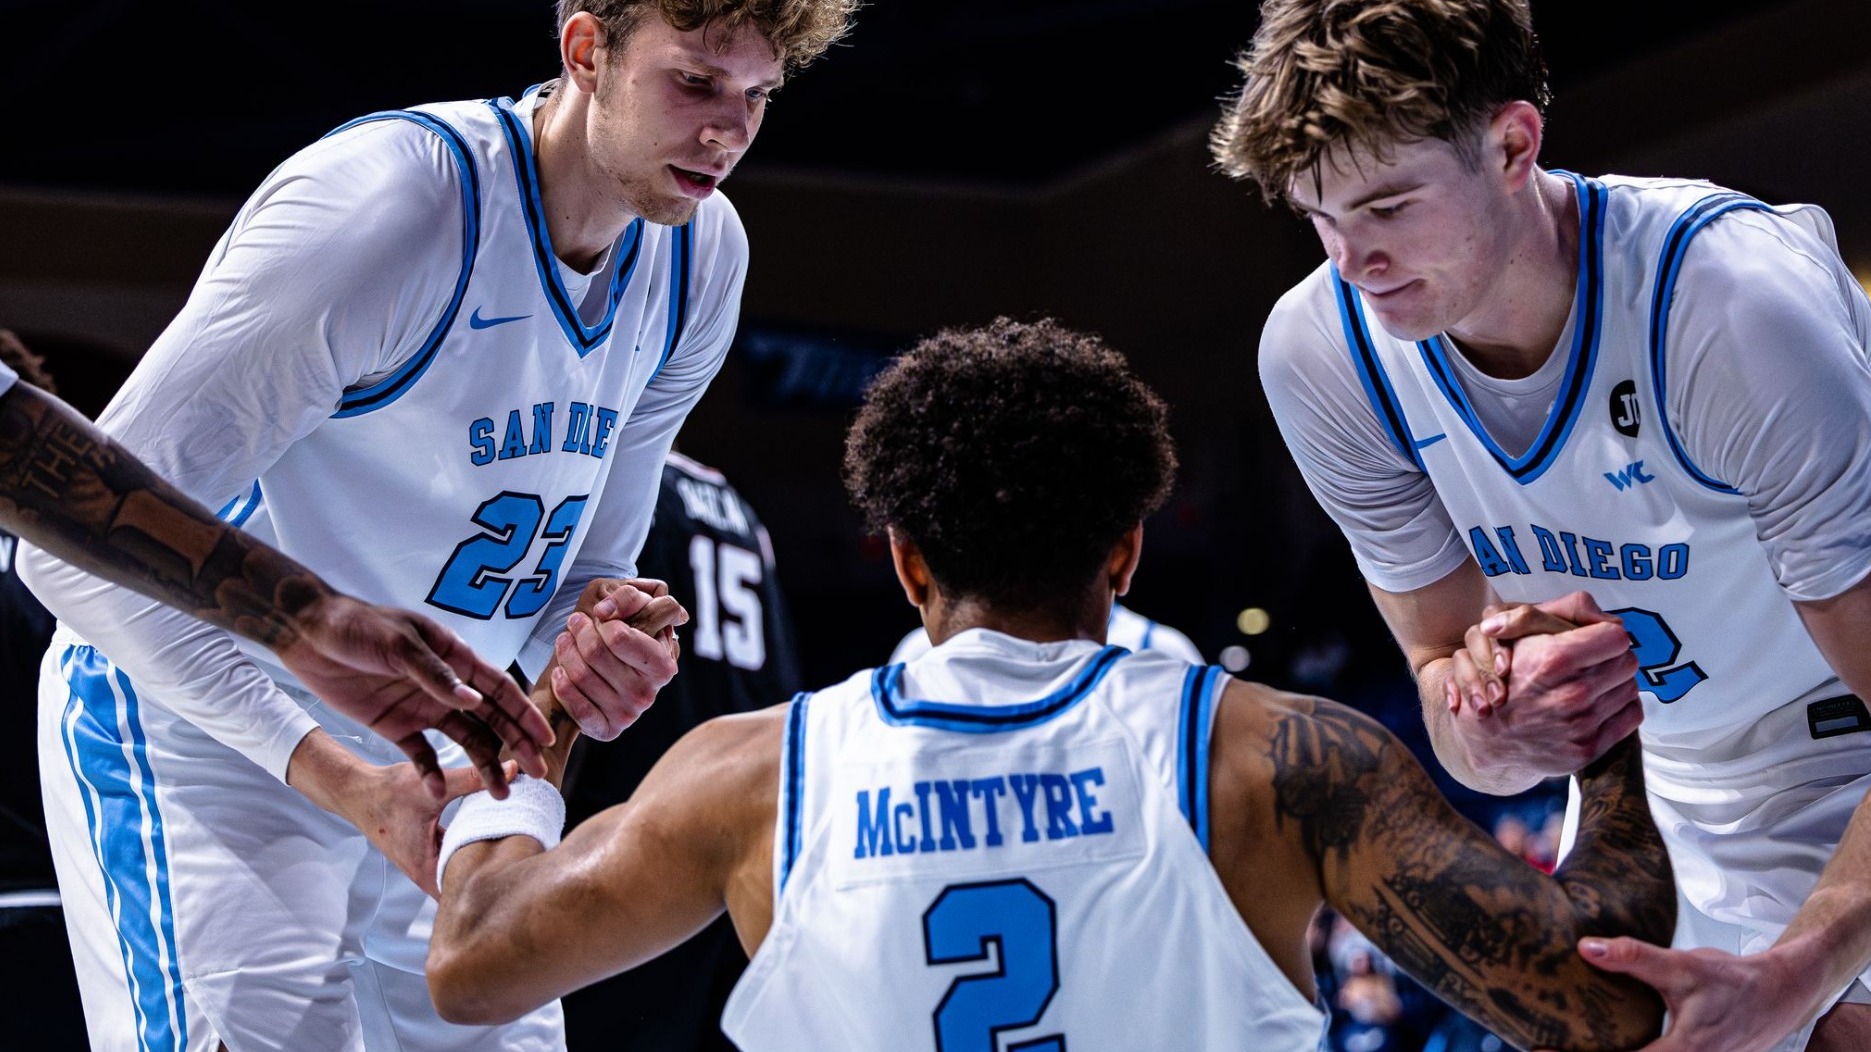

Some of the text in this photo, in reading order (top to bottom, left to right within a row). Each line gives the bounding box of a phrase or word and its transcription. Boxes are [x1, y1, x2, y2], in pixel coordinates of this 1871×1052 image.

[21, 423, 94, 498] THE
[469, 402, 554, 467] SAN
[424, 490, 590, 620] 23
[1530, 523, 1690, 581] DIEGO
[688, 534, 767, 672] 15
[854, 766, 1115, 860] McINTYRE
[922, 876, 1067, 1052] 2
